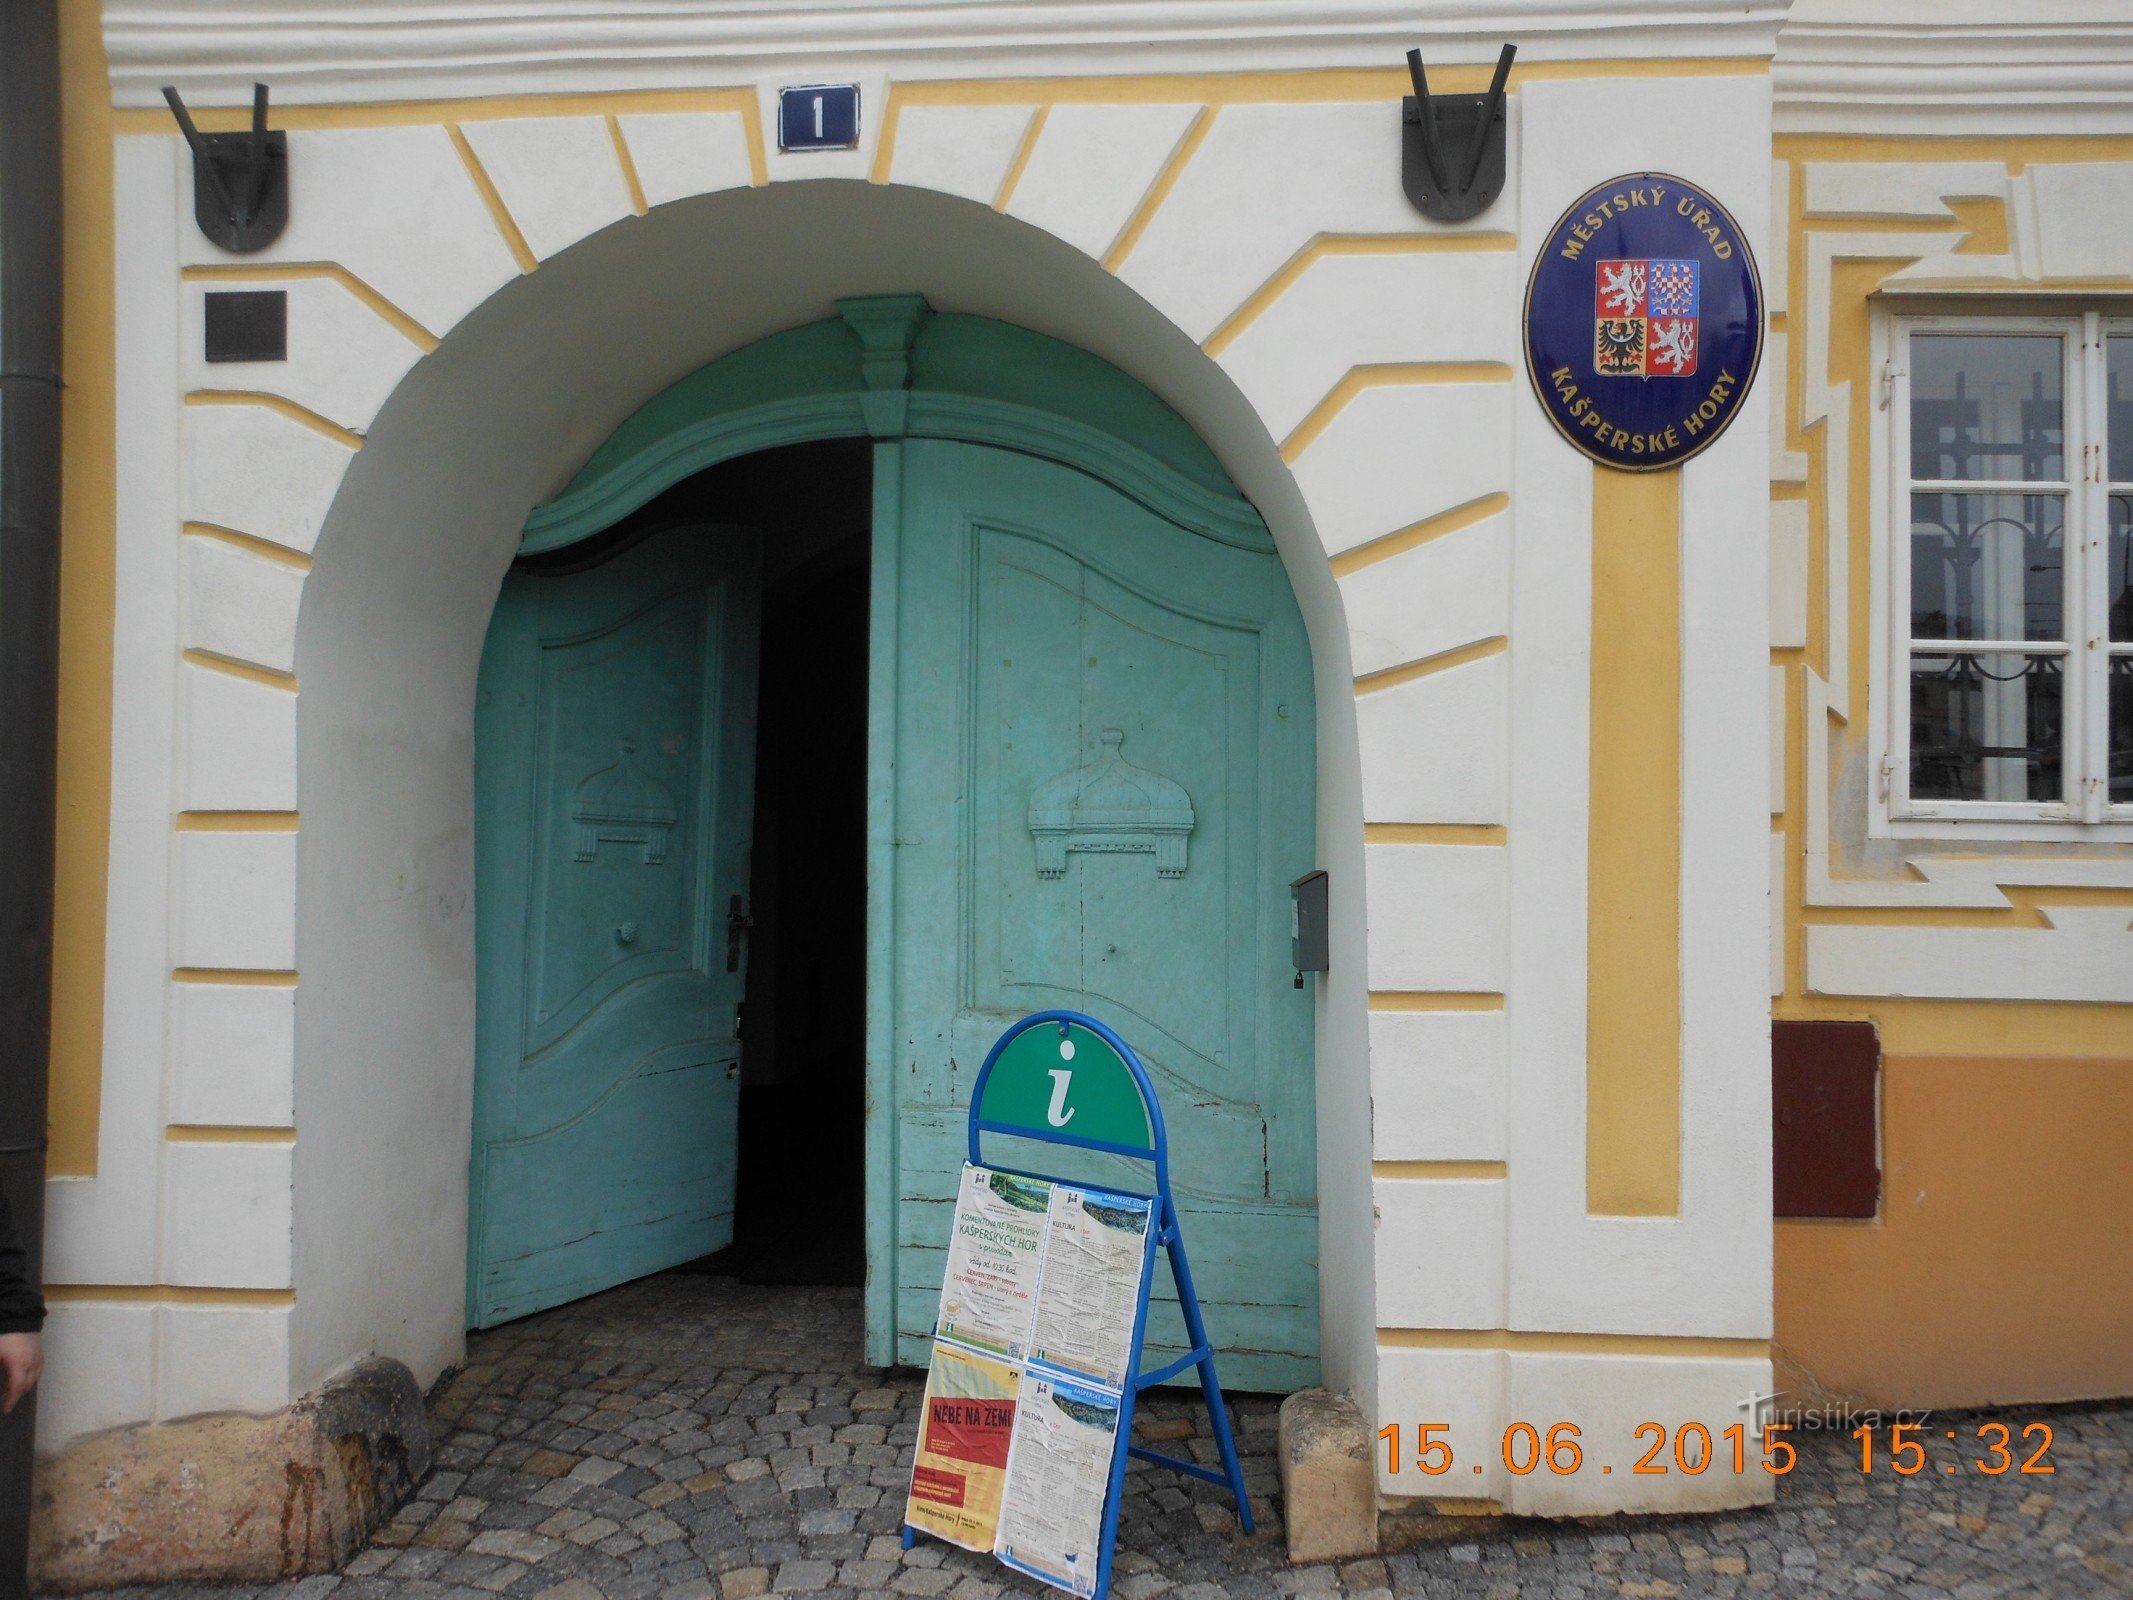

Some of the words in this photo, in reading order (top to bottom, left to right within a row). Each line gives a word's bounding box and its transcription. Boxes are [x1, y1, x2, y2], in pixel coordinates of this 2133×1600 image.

[813, 96, 823, 138] 1
[1560, 185, 1666, 261] MĚSTSKÝ
[1676, 196, 1732, 260] ÚŘAD
[1551, 366, 1680, 454] KAŠPERSKÉ
[1683, 367, 1736, 436] HORY
[959, 1223, 1018, 1248] KAŠPERSKÝCH
[1018, 1238, 1038, 1252] HOR
[1052, 1220, 1076, 1232] KULTURA
[933, 1404, 962, 1425] NEBE
[965, 1406, 981, 1426] NA
[984, 1407, 1011, 1428] ZEMI
[1021, 1409, 1045, 1423] KULTURA
